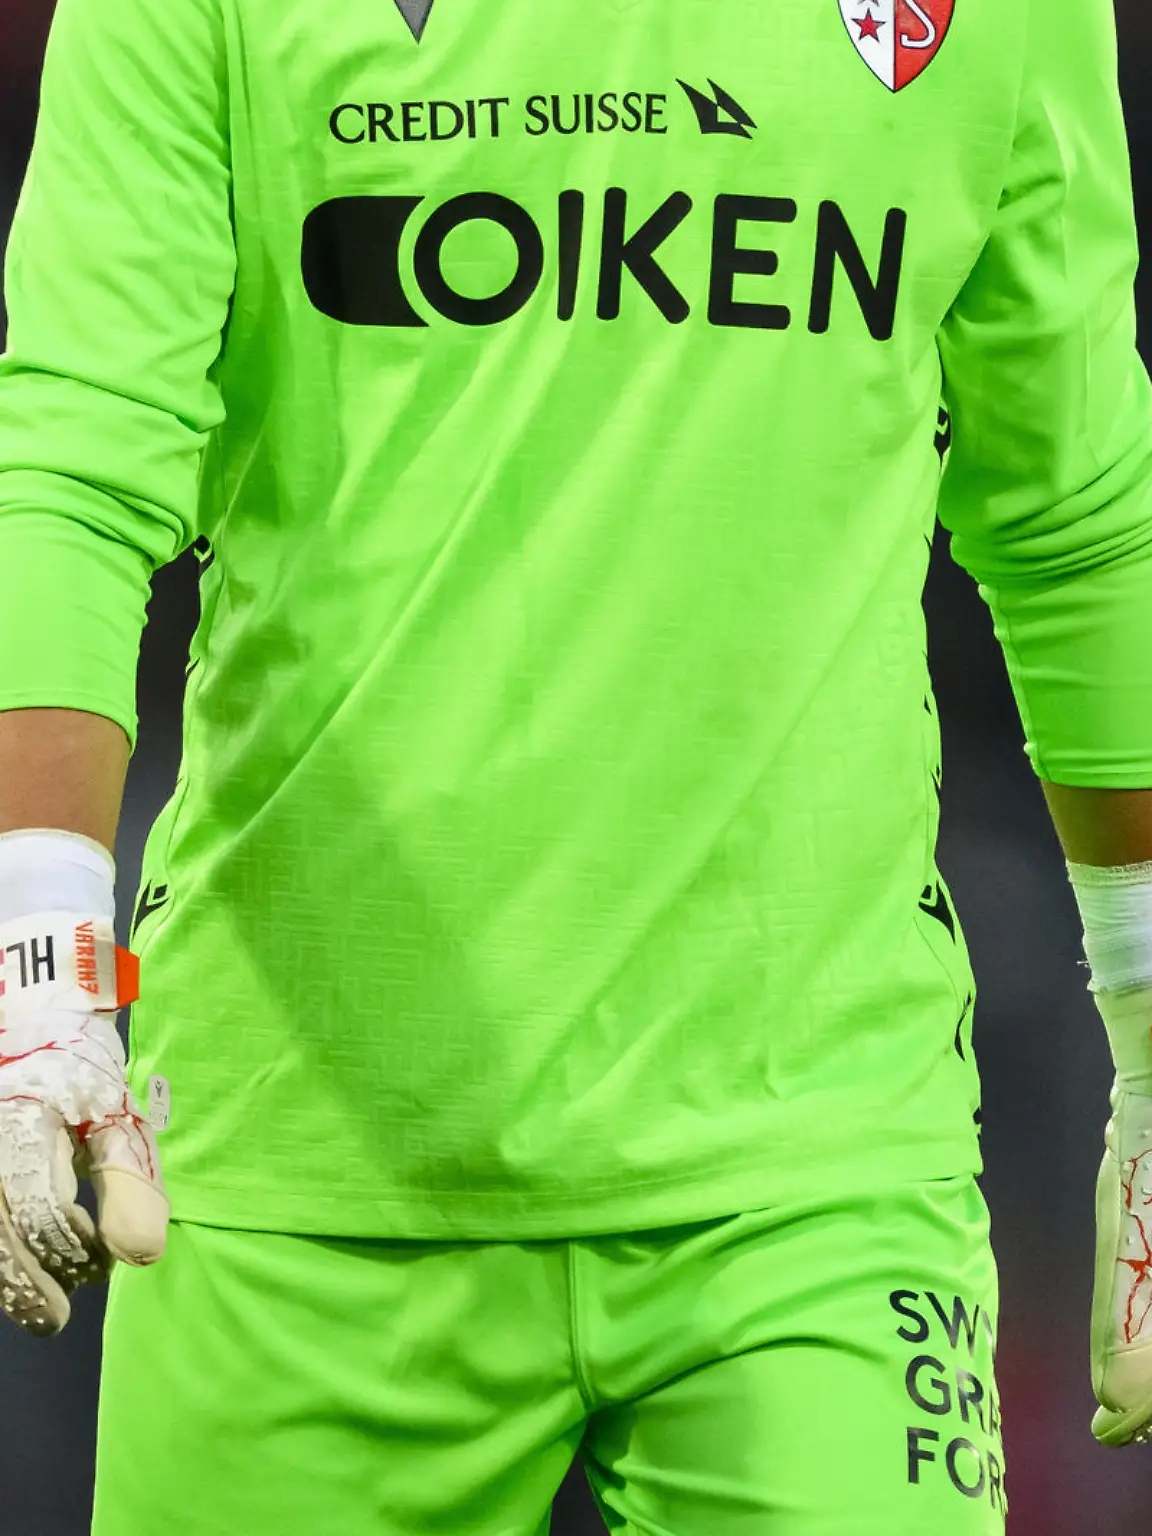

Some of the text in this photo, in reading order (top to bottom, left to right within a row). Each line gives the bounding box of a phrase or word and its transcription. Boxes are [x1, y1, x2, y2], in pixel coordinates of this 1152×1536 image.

[329, 92, 668, 144] CREDIT SUISSE
[413, 186, 907, 341] OIKEN
